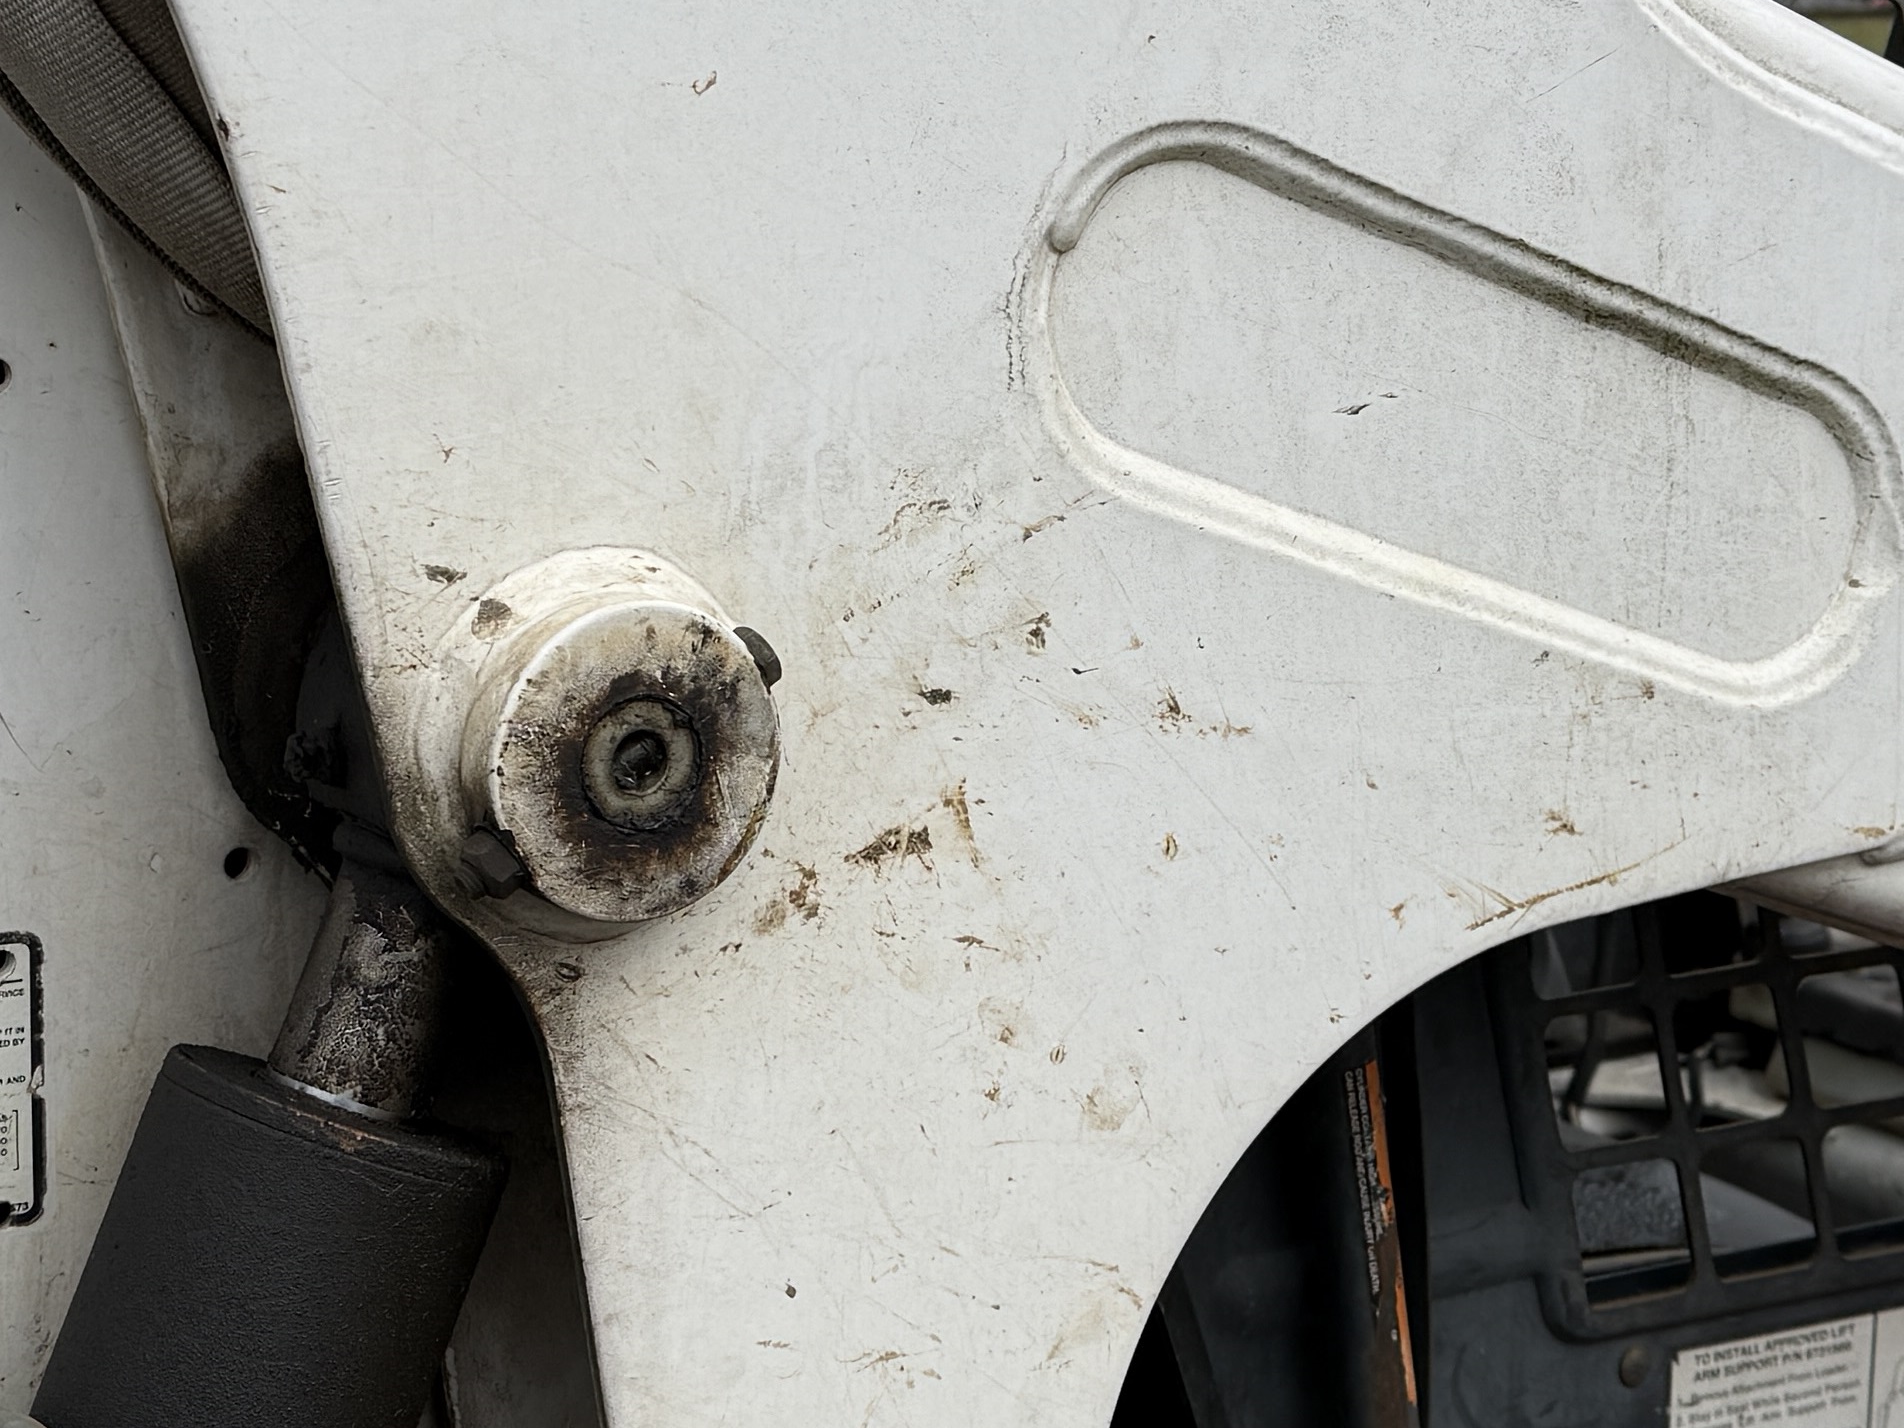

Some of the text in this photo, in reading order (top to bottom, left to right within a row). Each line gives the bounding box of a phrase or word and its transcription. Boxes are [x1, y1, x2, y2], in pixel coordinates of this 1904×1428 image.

[5, 1027, 12, 1035] IT
[15, 1026, 24, 1034] IN
[12, 1037, 25, 1046] BY
[7, 1074, 25, 1084] AND
[1345, 1071, 1355, 1091] CAN
[1348, 1092, 1360, 1133] RELEASE
[1358, 1178, 1369, 1209] CAUSE
[1363, 1211, 1375, 1244] INJURY
[1693, 1351, 1710, 1365] TO
[1713, 1344, 1759, 1361] INSTALL
[1764, 1329, 1828, 1351] APPROVED
[1830, 1322, 1855, 1338] LIFT
